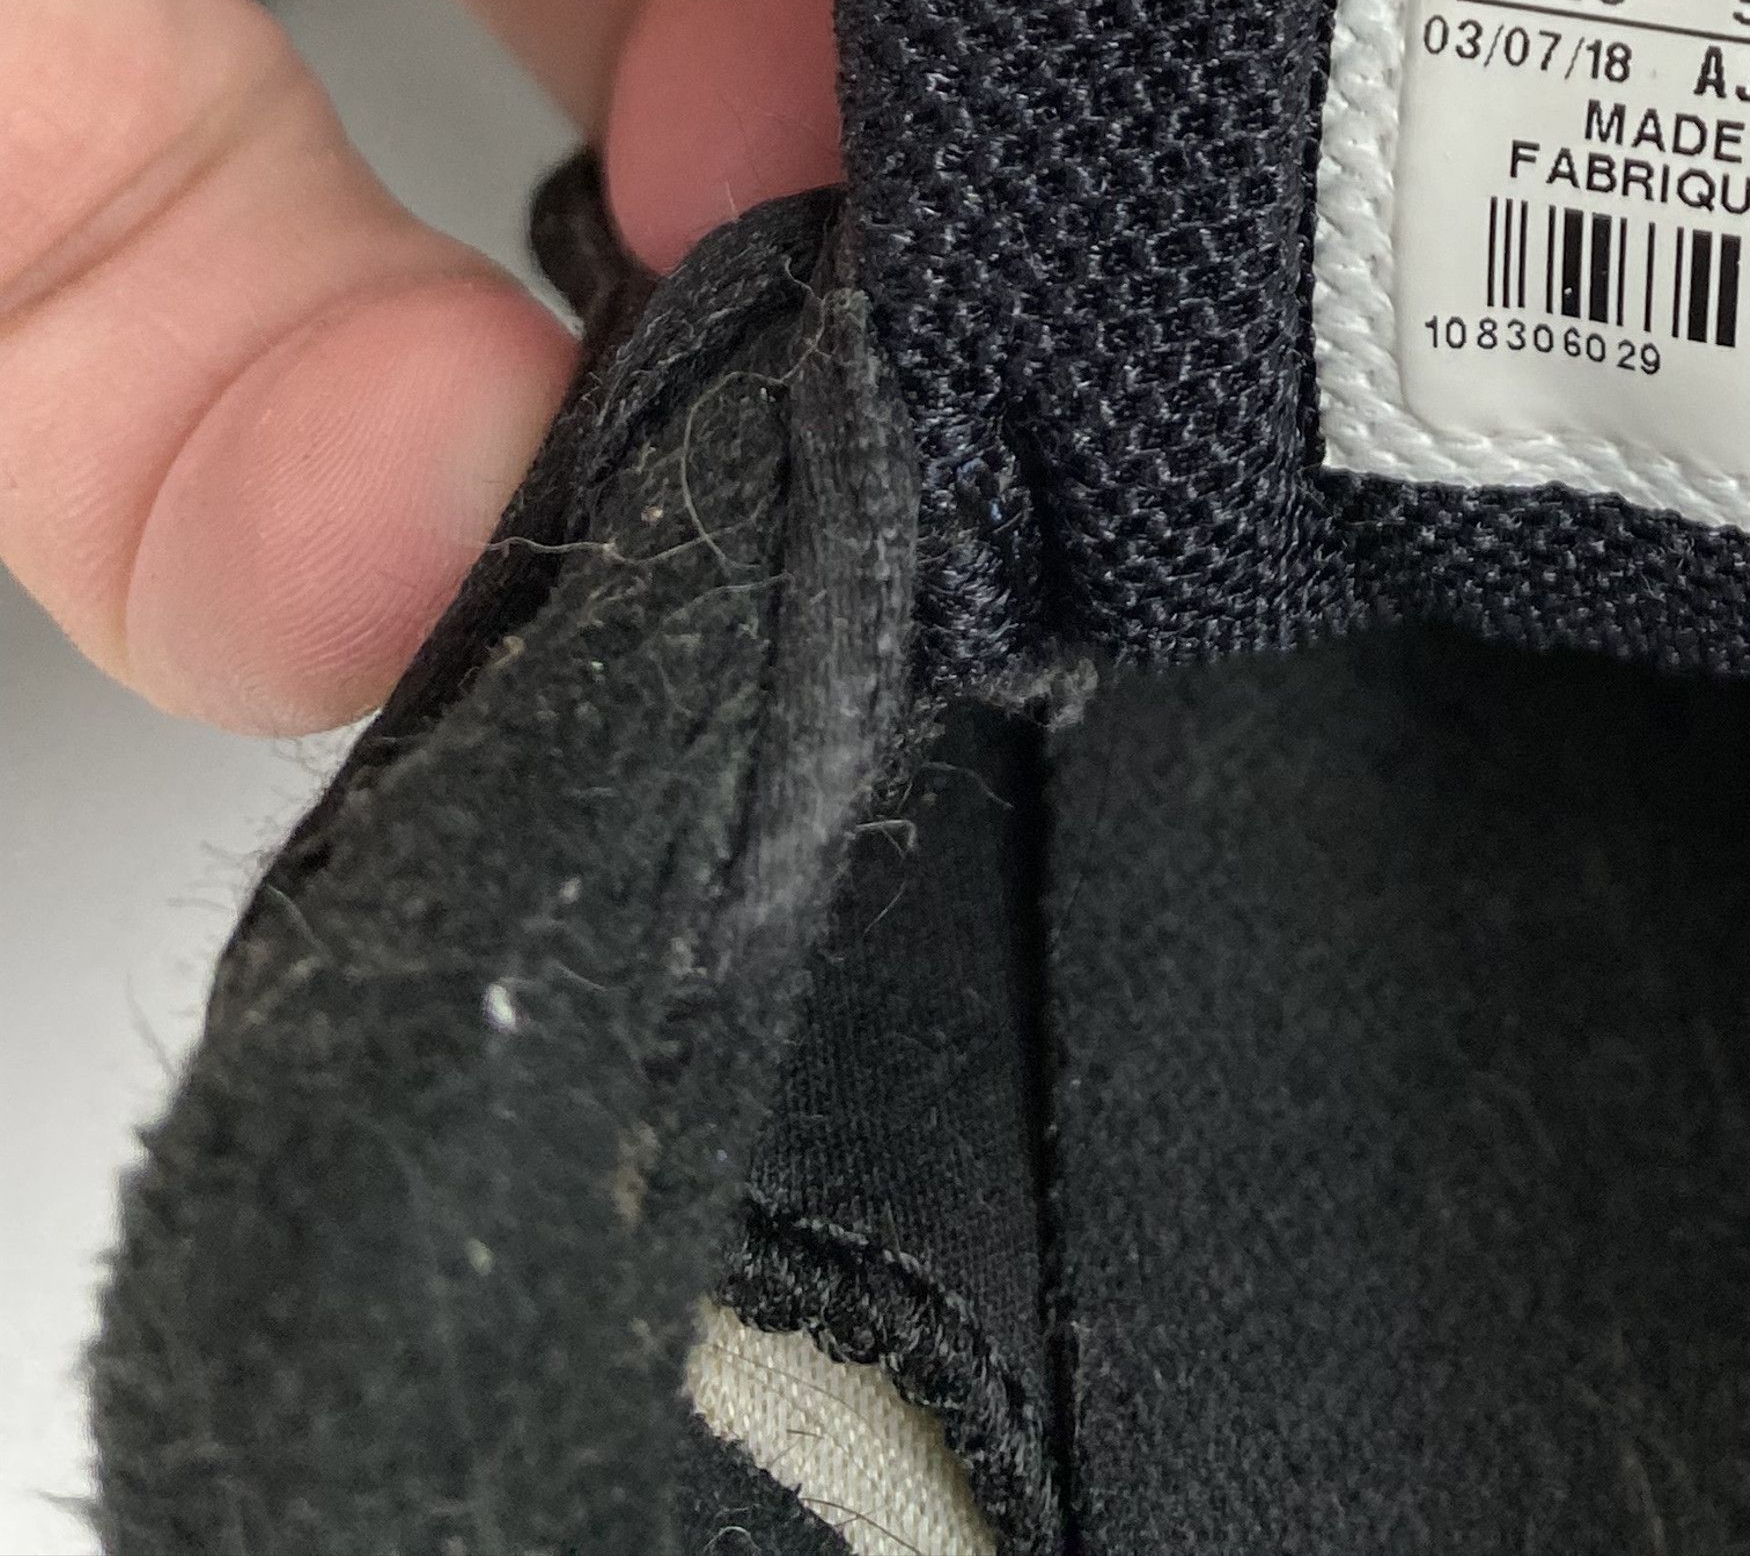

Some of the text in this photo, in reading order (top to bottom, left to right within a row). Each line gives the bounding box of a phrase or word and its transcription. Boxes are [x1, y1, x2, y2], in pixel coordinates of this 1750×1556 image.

[1424, 15, 1632, 84] 03/07/18
[1585, 99, 1745, 164] MADE
[1424, 315, 1661, 375] 108306029
